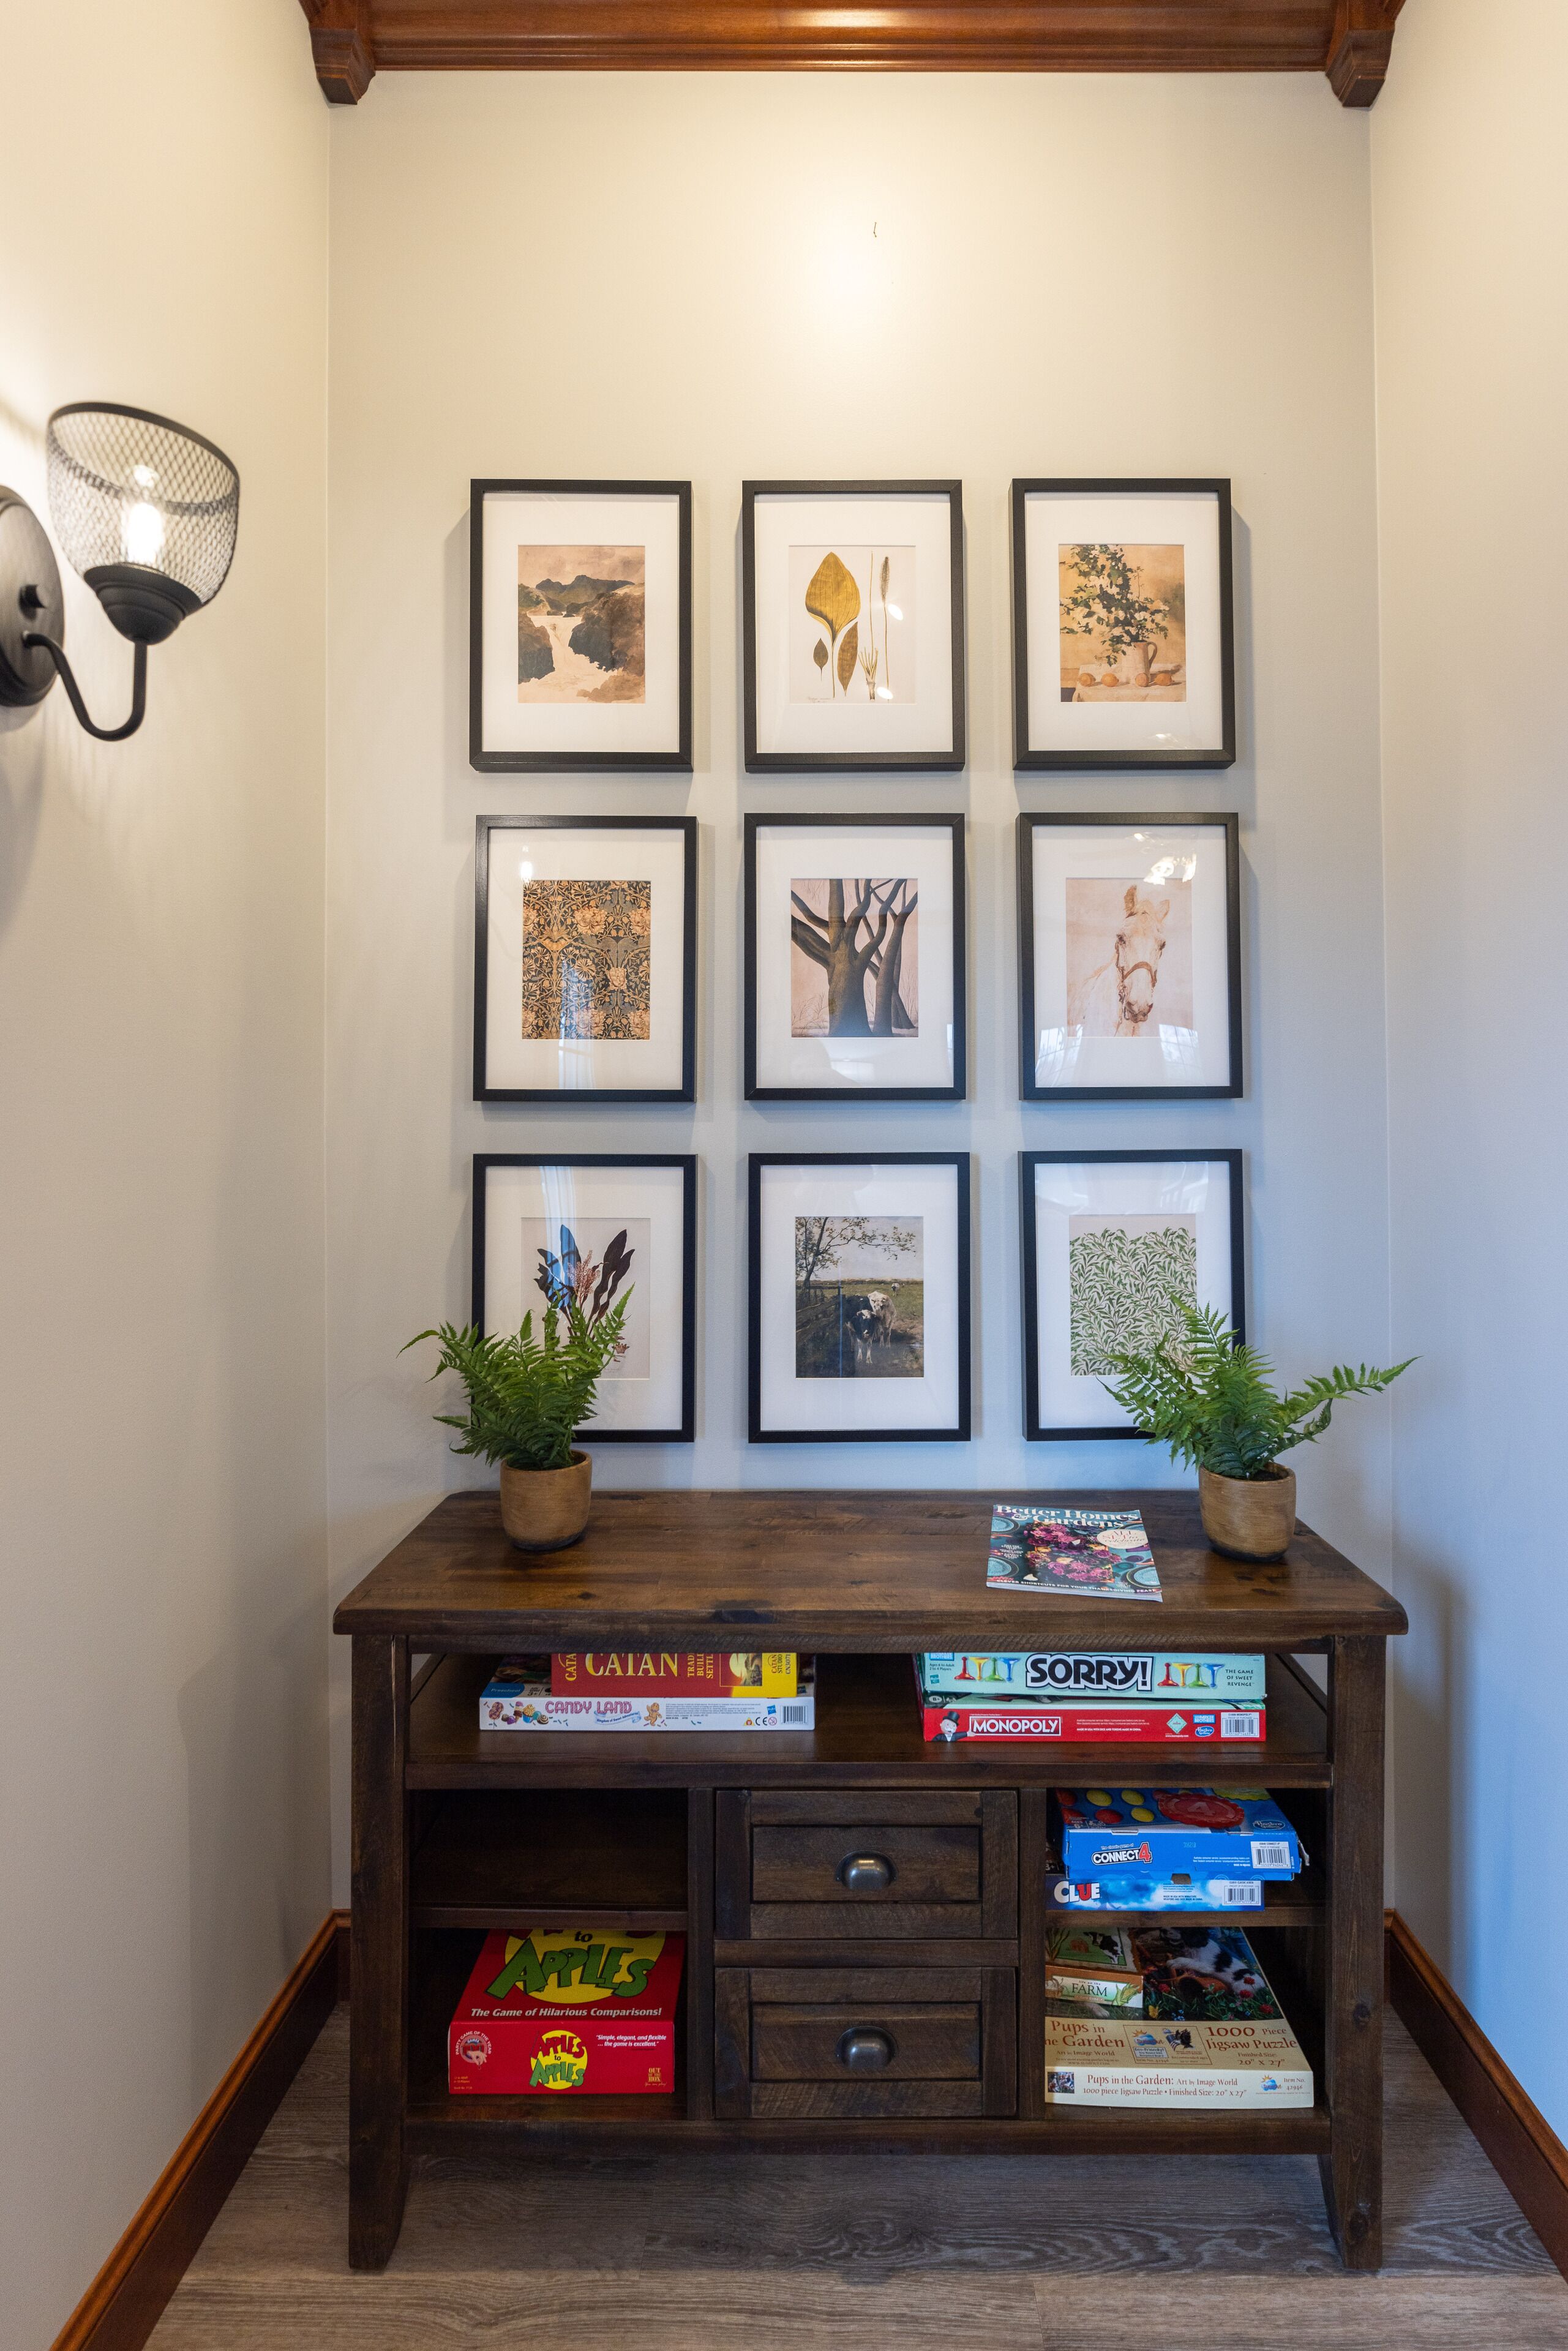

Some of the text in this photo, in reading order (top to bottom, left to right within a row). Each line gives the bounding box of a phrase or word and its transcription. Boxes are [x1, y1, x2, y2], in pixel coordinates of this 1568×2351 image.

[996, 1505, 1139, 1521] Better Homes
[1033, 1515, 1125, 1528] Gardens
[565, 1653, 577, 1681] CATA
[585, 1652, 678, 1677] CATAN
[1029, 1657, 1149, 1687] SORRY!
[545, 1700, 632, 1714] CANDY LAND
[973, 1719, 1059, 1733] MONOPOLY
[1093, 1843, 1151, 1864] CONNECT 4
[1054, 1880, 1101, 1904] CLUE
[574, 1930, 593, 1943] to
[484, 1937, 657, 2001] APPLES
[1071, 1982, 1108, 1997] FARM
[471, 2008, 662, 2019] The Game of Hilarious Comparisons!
[460, 2030, 473, 2040] GAME
[481, 2033, 489, 2041] THE
[1051, 2020, 1105, 2036] Pups in
[1204, 2027, 1286, 2037] 1000 Piece
[530, 2031, 585, 2060] APPLES
[1062, 2034, 1125, 2048] Garden
[1205, 2037, 1299, 2052] Jigsaw Puzzle
[529, 2058, 585, 2087] APPLES
[1087, 2074, 1109, 2086] Pups
[1111, 2075, 1119, 2085] in
[1121, 2075, 1133, 2085] the
[1136, 2074, 1174, 2085] Garden:
[1196, 2078, 1215, 2087] Image
[1101, 2087, 1119, 2096] piece
[1120, 2088, 1141, 2096] Jigsaw
